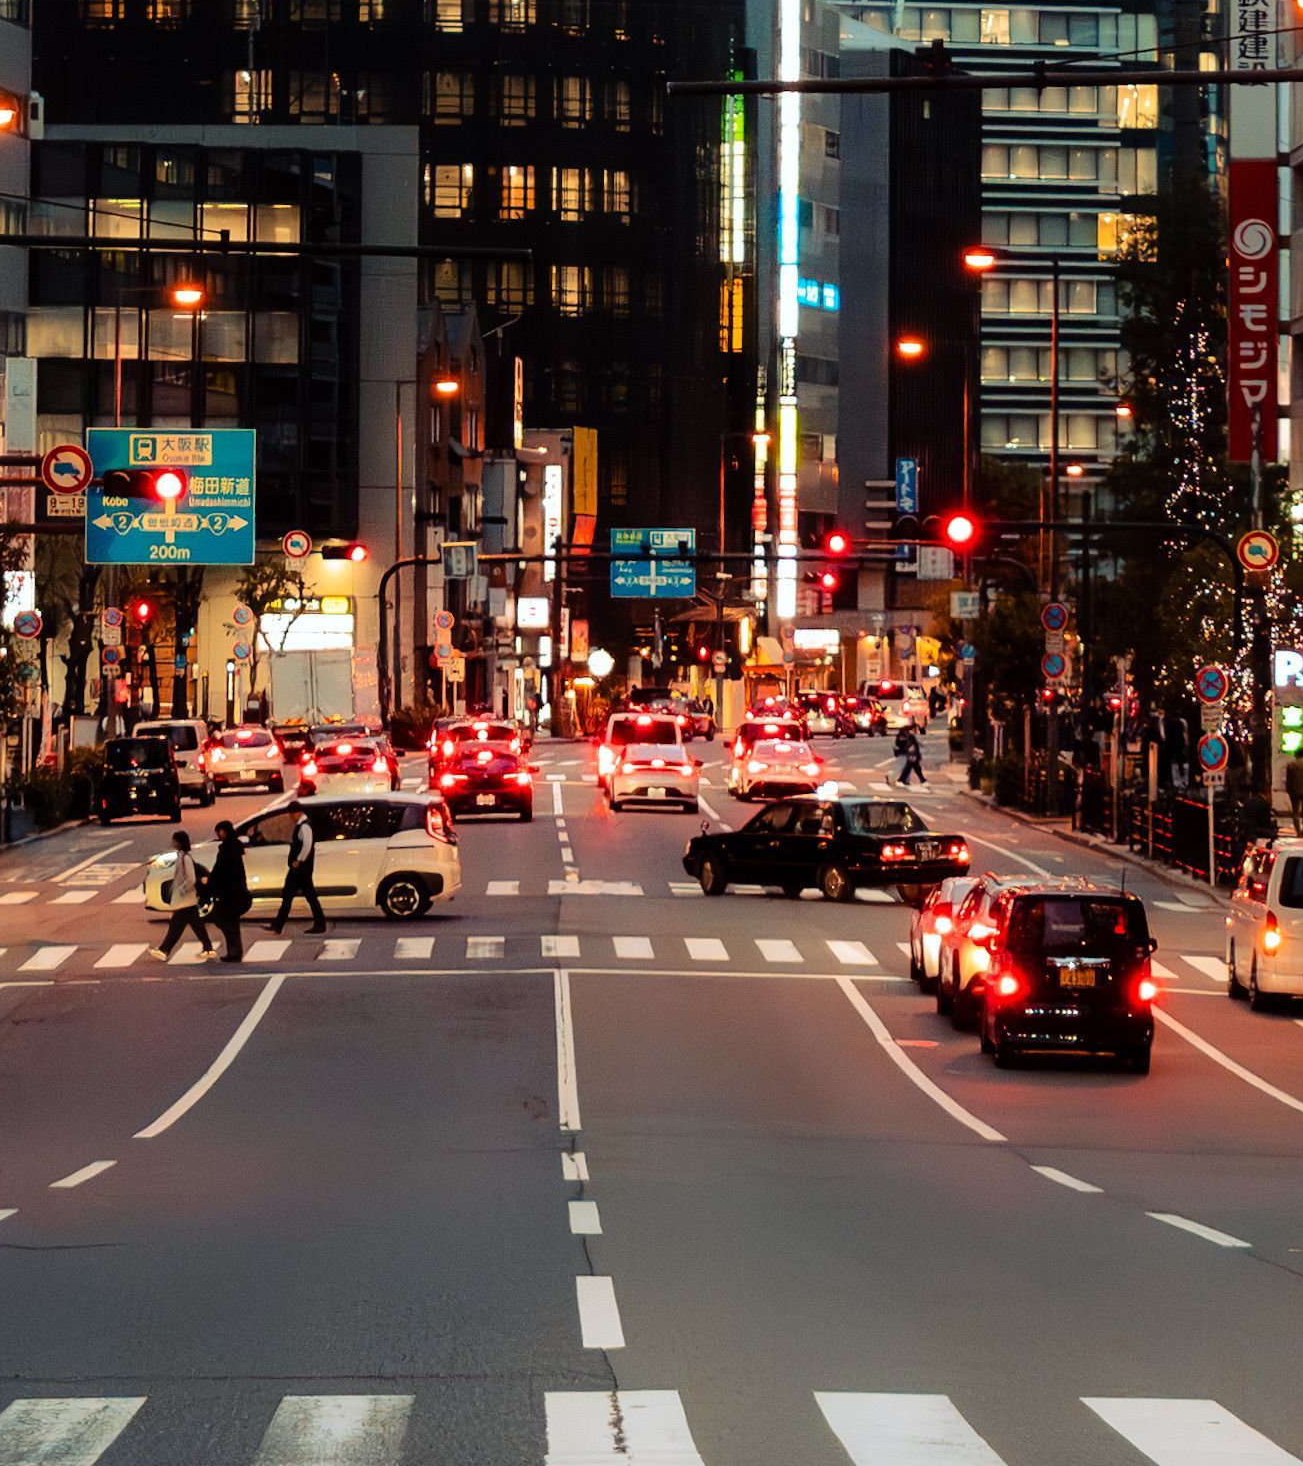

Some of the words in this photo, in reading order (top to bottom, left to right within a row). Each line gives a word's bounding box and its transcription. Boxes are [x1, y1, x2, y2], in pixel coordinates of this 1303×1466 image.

[1239, 266, 1268, 408] シモジマ
[161, 437, 210, 452] 大阪駅
[189, 476, 250, 495] 梅田新道
[102, 496, 129, 507] Kobe
[118, 515, 127, 528] 2
[213, 515, 223, 530] 2
[149, 545, 191, 560] 200m
